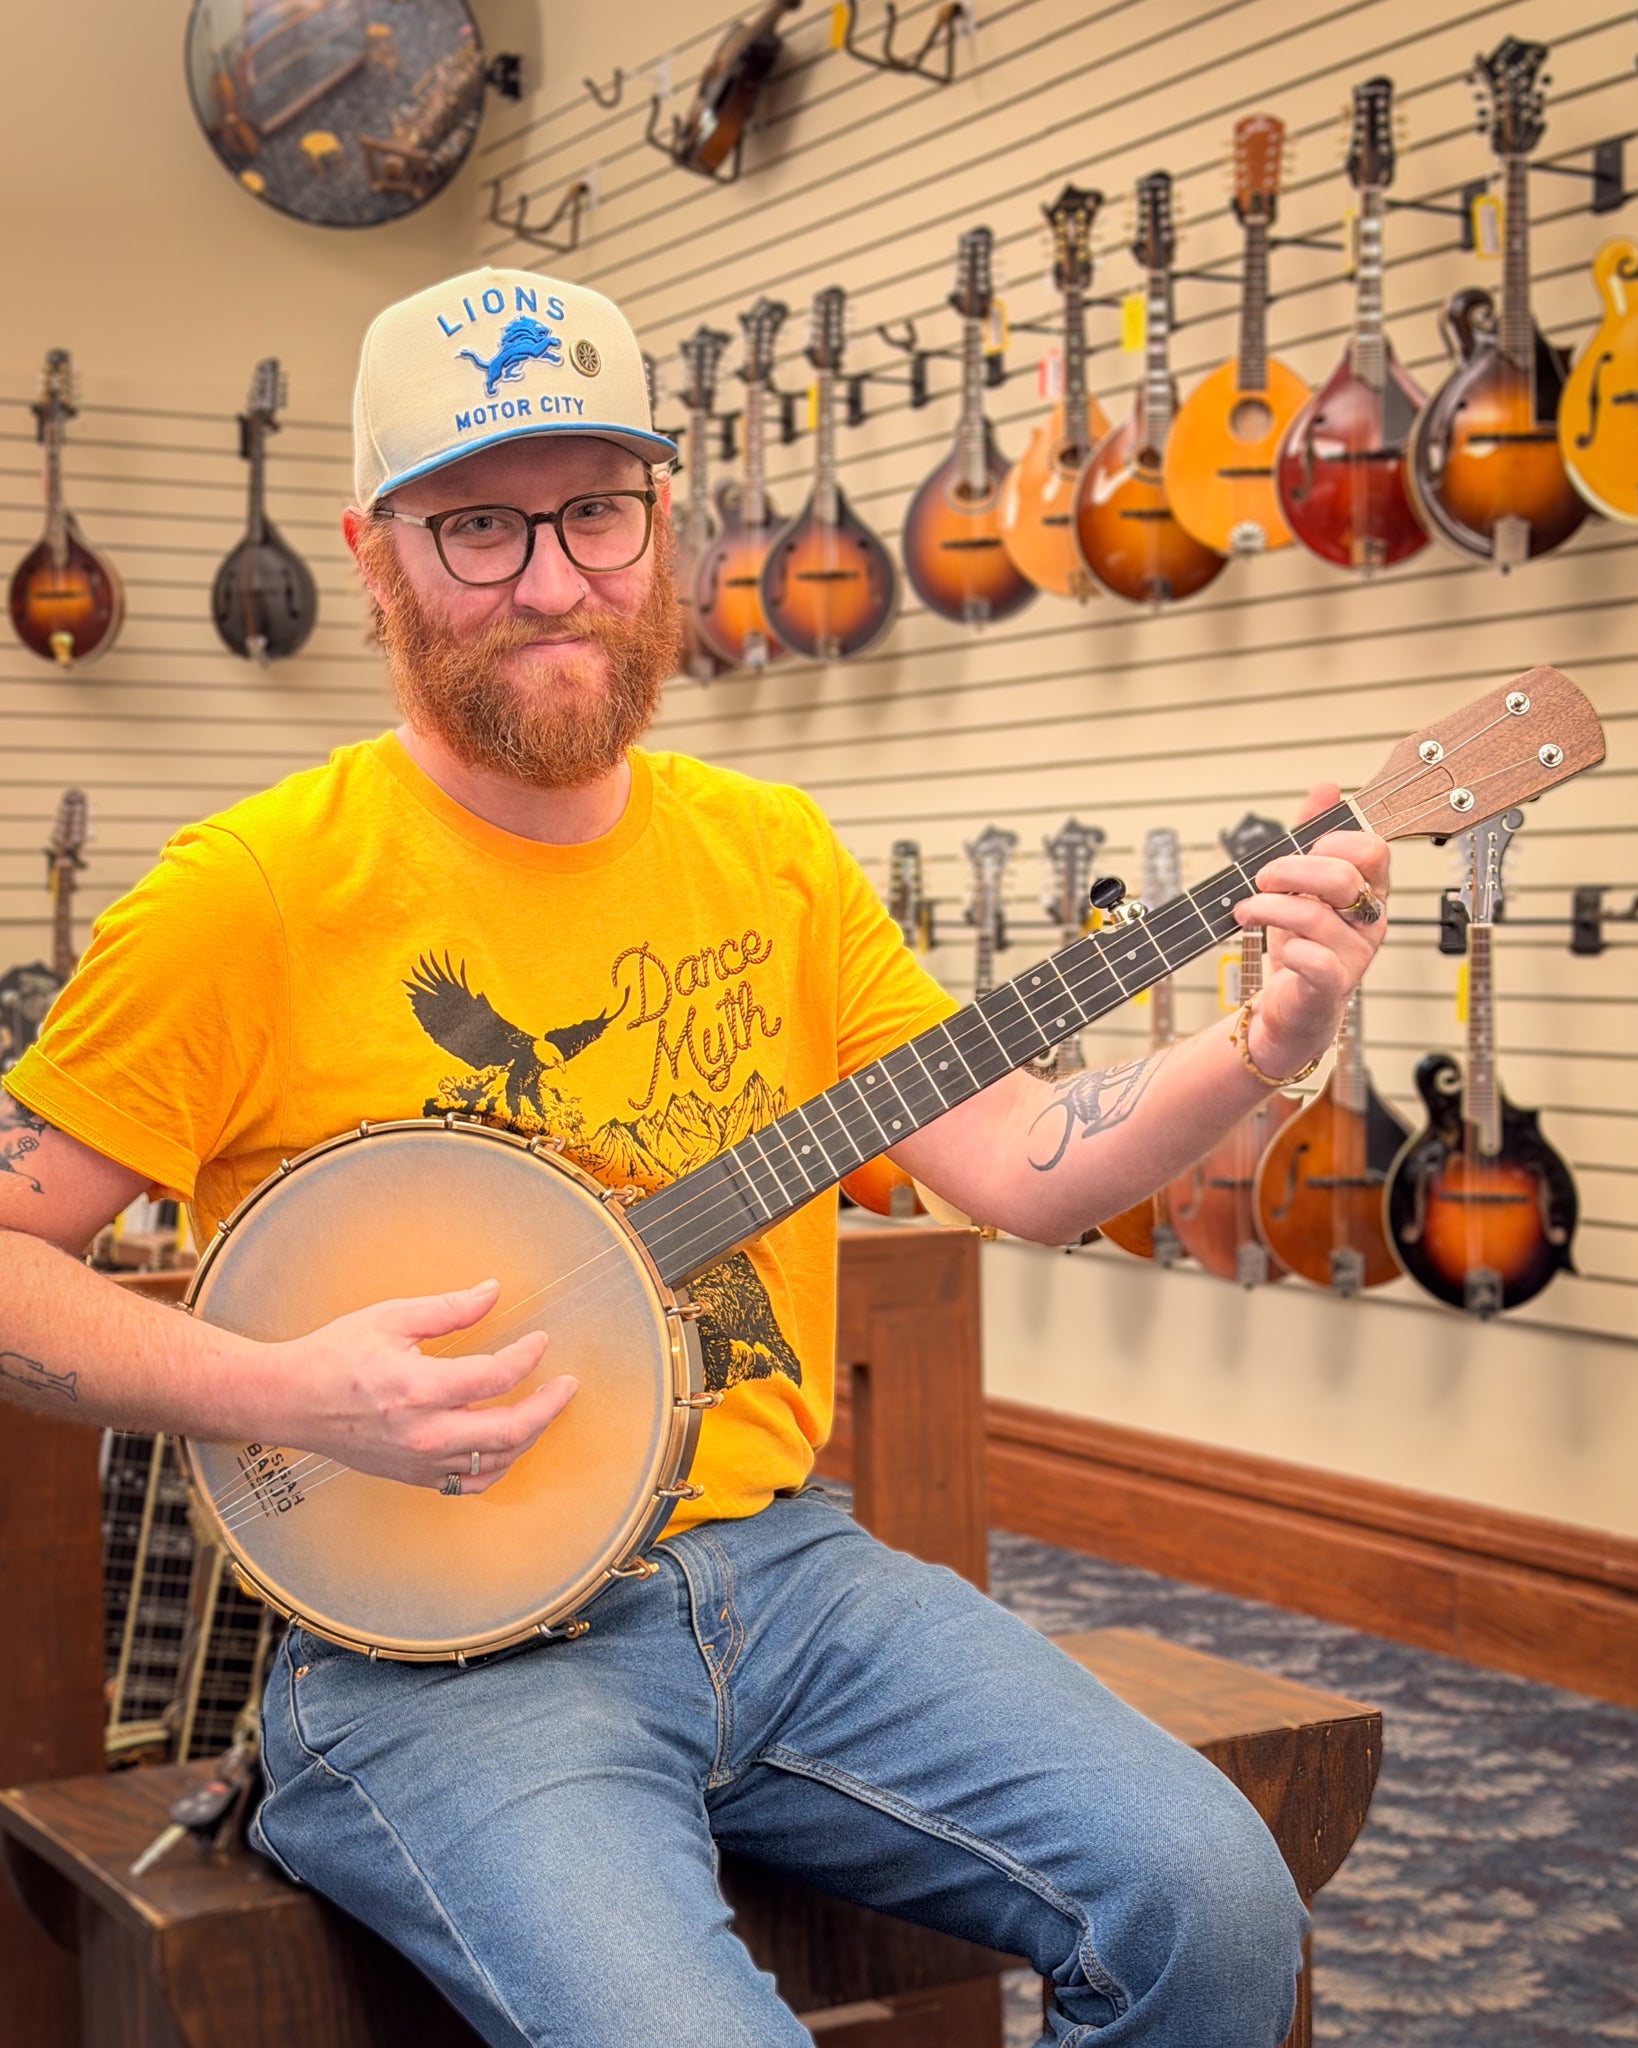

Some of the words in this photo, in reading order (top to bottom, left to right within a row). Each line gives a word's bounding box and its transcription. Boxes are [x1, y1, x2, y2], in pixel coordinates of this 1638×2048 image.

[436, 286, 565, 337] LIONS
[455, 398, 532, 432] MOTOR
[540, 395, 584, 415] CITY
[611, 929, 773, 1031] Dance
[627, 980, 782, 1110] Myth
[247, 1443, 292, 1513] BANJO
[266, 1446, 305, 1506] ISGAH
